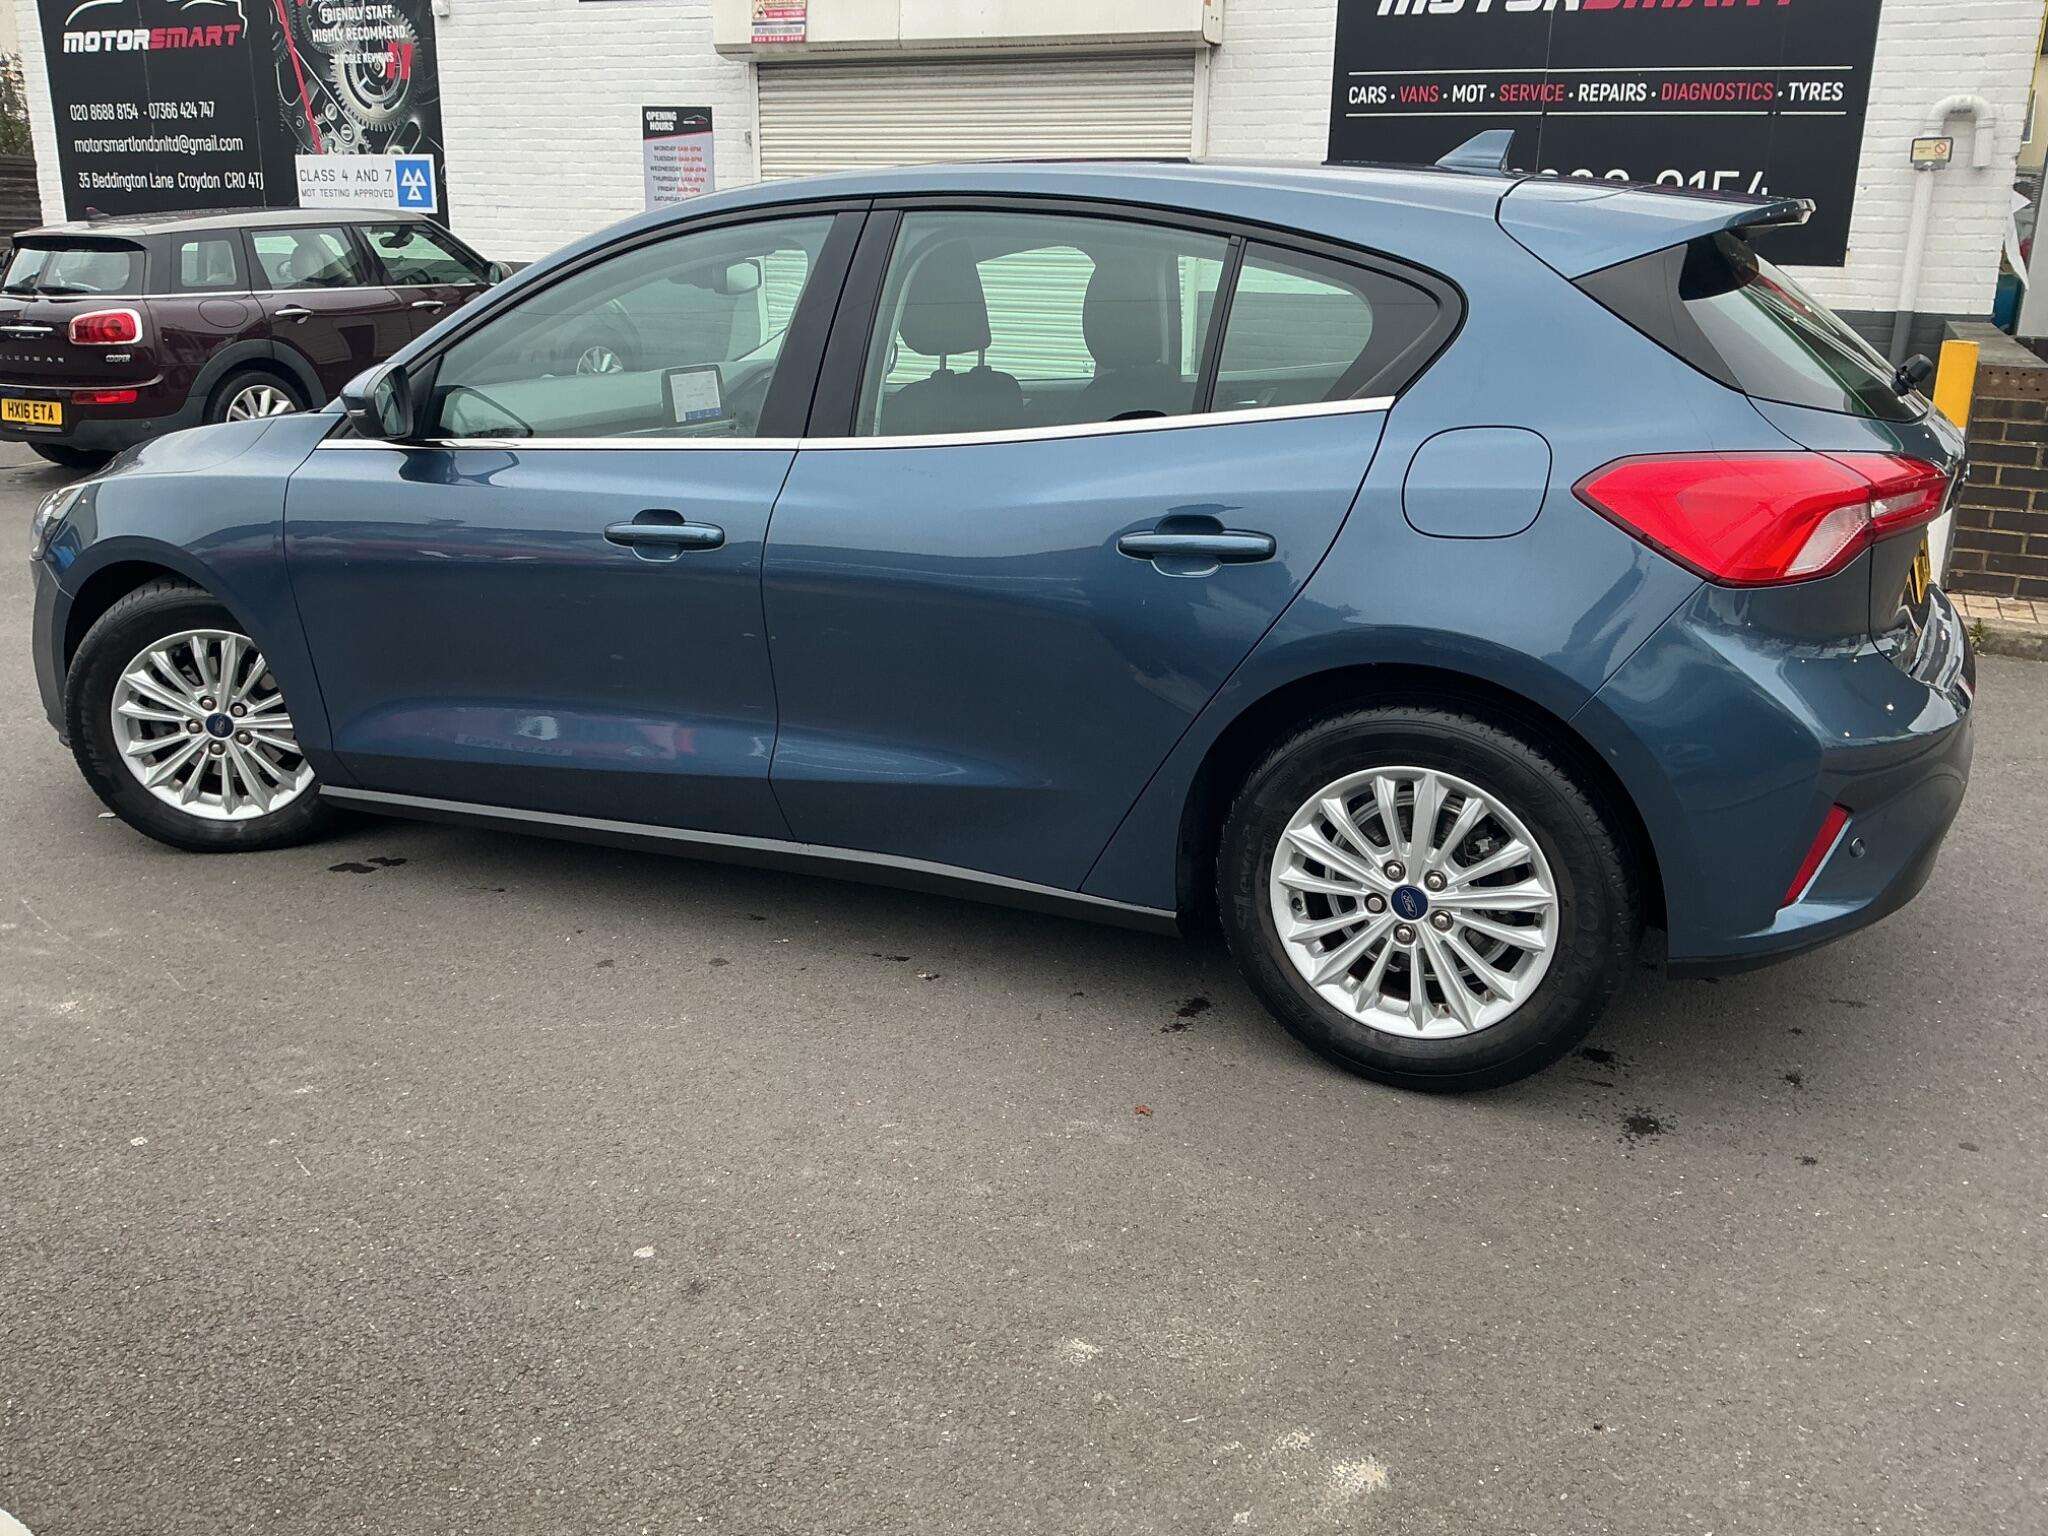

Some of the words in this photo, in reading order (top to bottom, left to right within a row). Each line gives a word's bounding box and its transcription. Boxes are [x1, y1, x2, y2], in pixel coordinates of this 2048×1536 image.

[321, 7, 363, 21] FRIENDLY
[365, 4, 395, 19] STAFF.
[63, 24, 241, 53] MOTORSMART
[312, 28, 344, 42] HIGHLY
[346, 25, 408, 41] RECOMMEND.
[1348, 85, 1387, 104] CARS
[1400, 84, 1439, 103] VANS
[1452, 84, 1487, 103] MOT
[1499, 83, 1564, 102] SERVICE
[1577, 82, 1647, 102] REPAIRS
[1661, 81, 1774, 101] DIAGNOSTICS
[1788, 81, 1844, 102] TYRES
[70, 104, 88, 121] 020
[90, 103, 115, 121] 8688
[116, 103, 138, 120] 8154
[148, 102, 178, 120] 07366
[180, 102, 198, 119] 424
[198, 101, 215, 119] 747
[646, 111, 677, 121] OPENING
[649, 121, 674, 131] HOURS
[74, 135, 243, 155] motorsmartlondonltd@gmail.com
[78, 172, 91, 189] 35
[92, 172, 148, 192] Beddington
[150, 172, 174, 189] Lane
[178, 172, 220, 192] Croydon
[299, 169, 335, 182] CLASS
[341, 169, 349, 181] 4
[355, 169, 379, 182] AND
[385, 169, 392, 182] 7
[301, 188, 316, 198] MOT
[319, 188, 350, 198] TESTING
[354, 188, 394, 198] APPROVED
[8, 402, 31, 419] HX16
[33, 403, 54, 421] ETA
